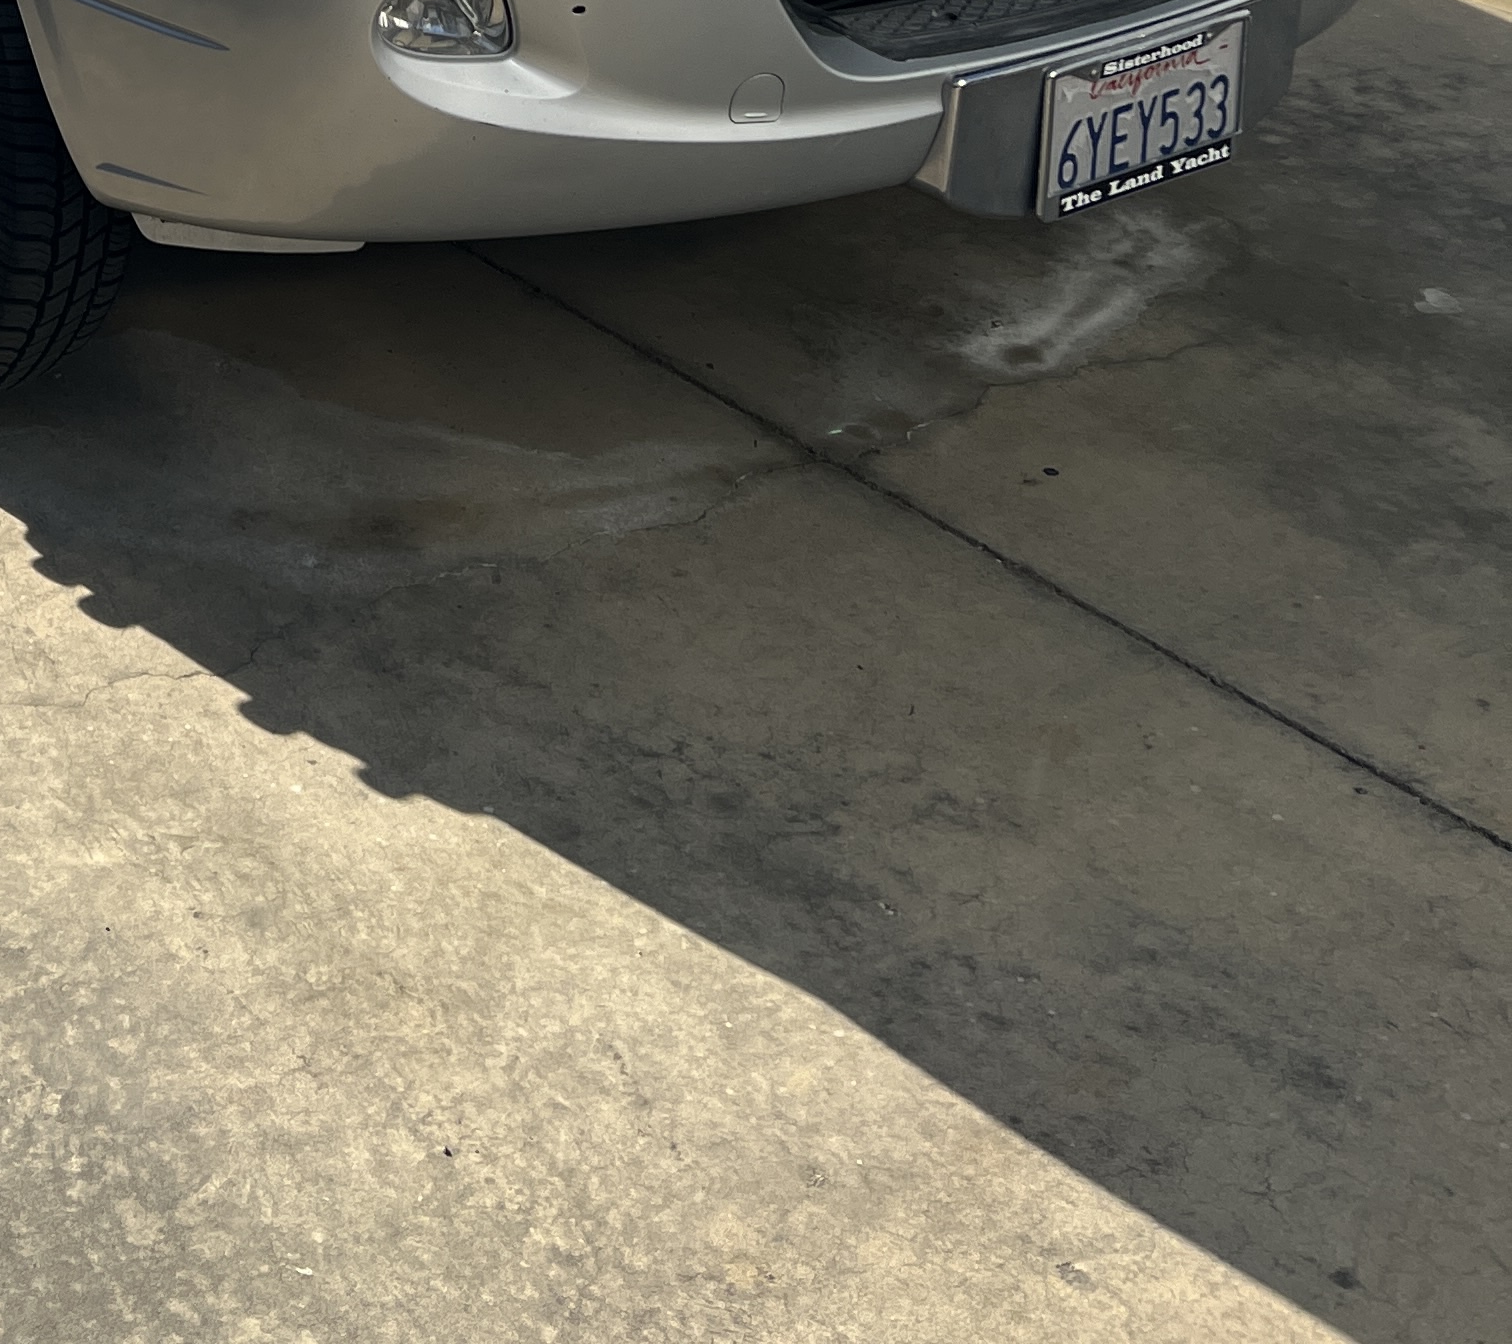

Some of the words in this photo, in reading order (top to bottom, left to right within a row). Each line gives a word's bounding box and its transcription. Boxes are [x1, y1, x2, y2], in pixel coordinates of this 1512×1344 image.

[1102, 33, 1204, 76] Sisterhood
[1056, 73, 1230, 189] 6YEY533
[1060, 189, 1102, 213] The
[1108, 164, 1165, 197] Land
[1169, 143, 1231, 175] Yacht
